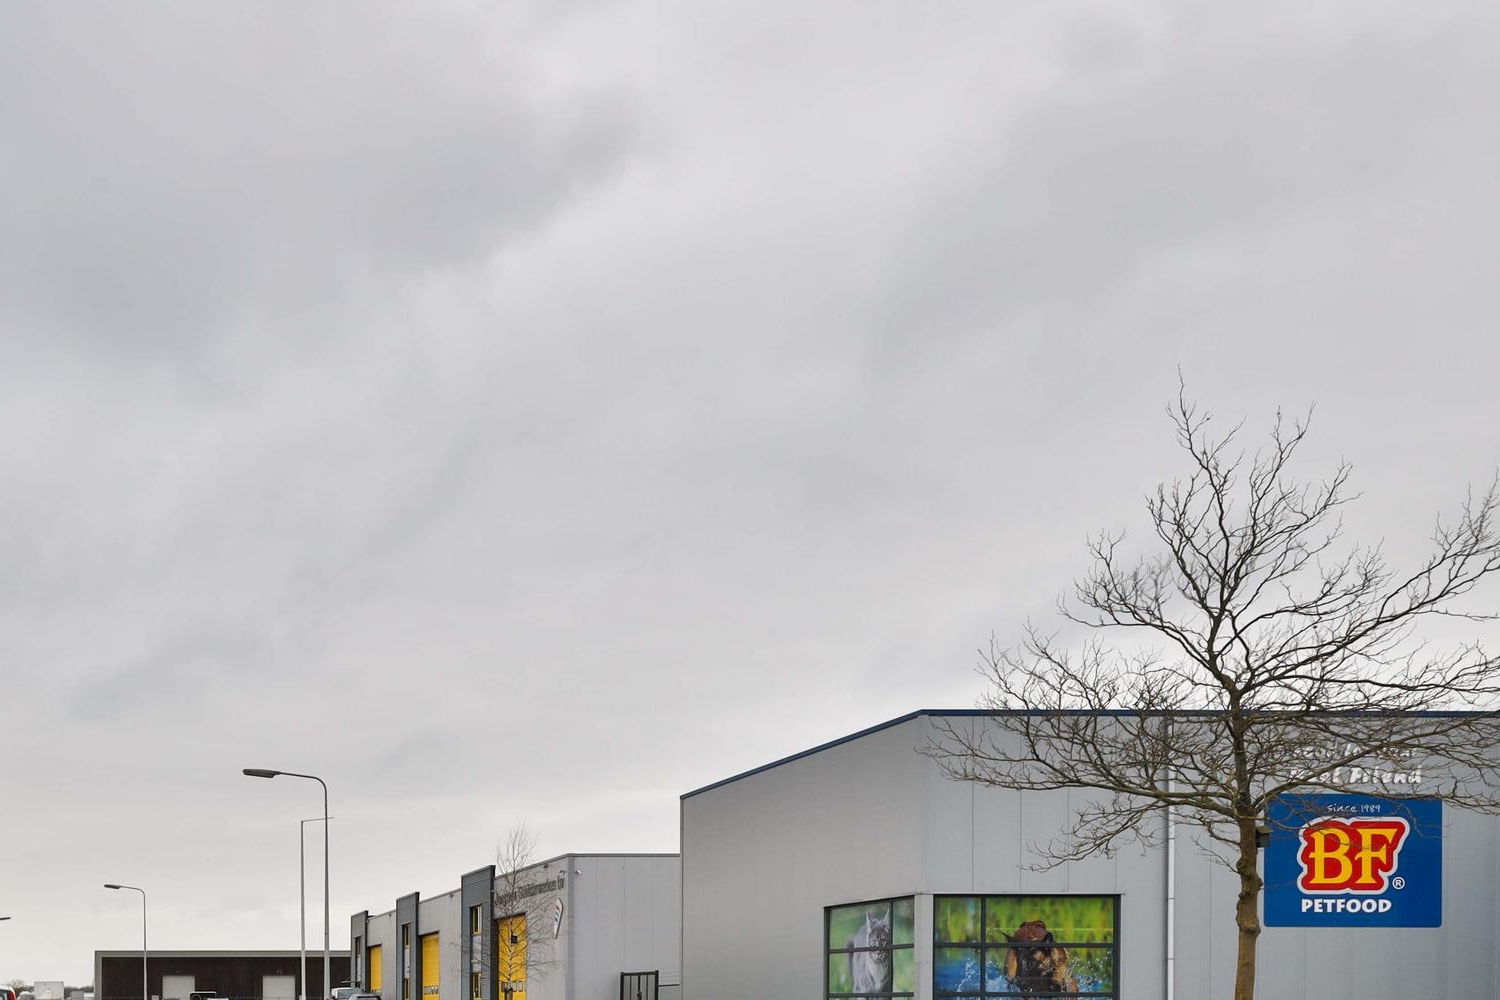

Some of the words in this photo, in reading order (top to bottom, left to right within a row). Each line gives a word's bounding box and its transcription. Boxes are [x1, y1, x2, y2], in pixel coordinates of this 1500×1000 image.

[1326, 804, 1357, 813] since
[1360, 804, 1381, 813] 1989
[1308, 827, 1398, 885] BF
[1301, 898, 1392, 914] PETFOOD
